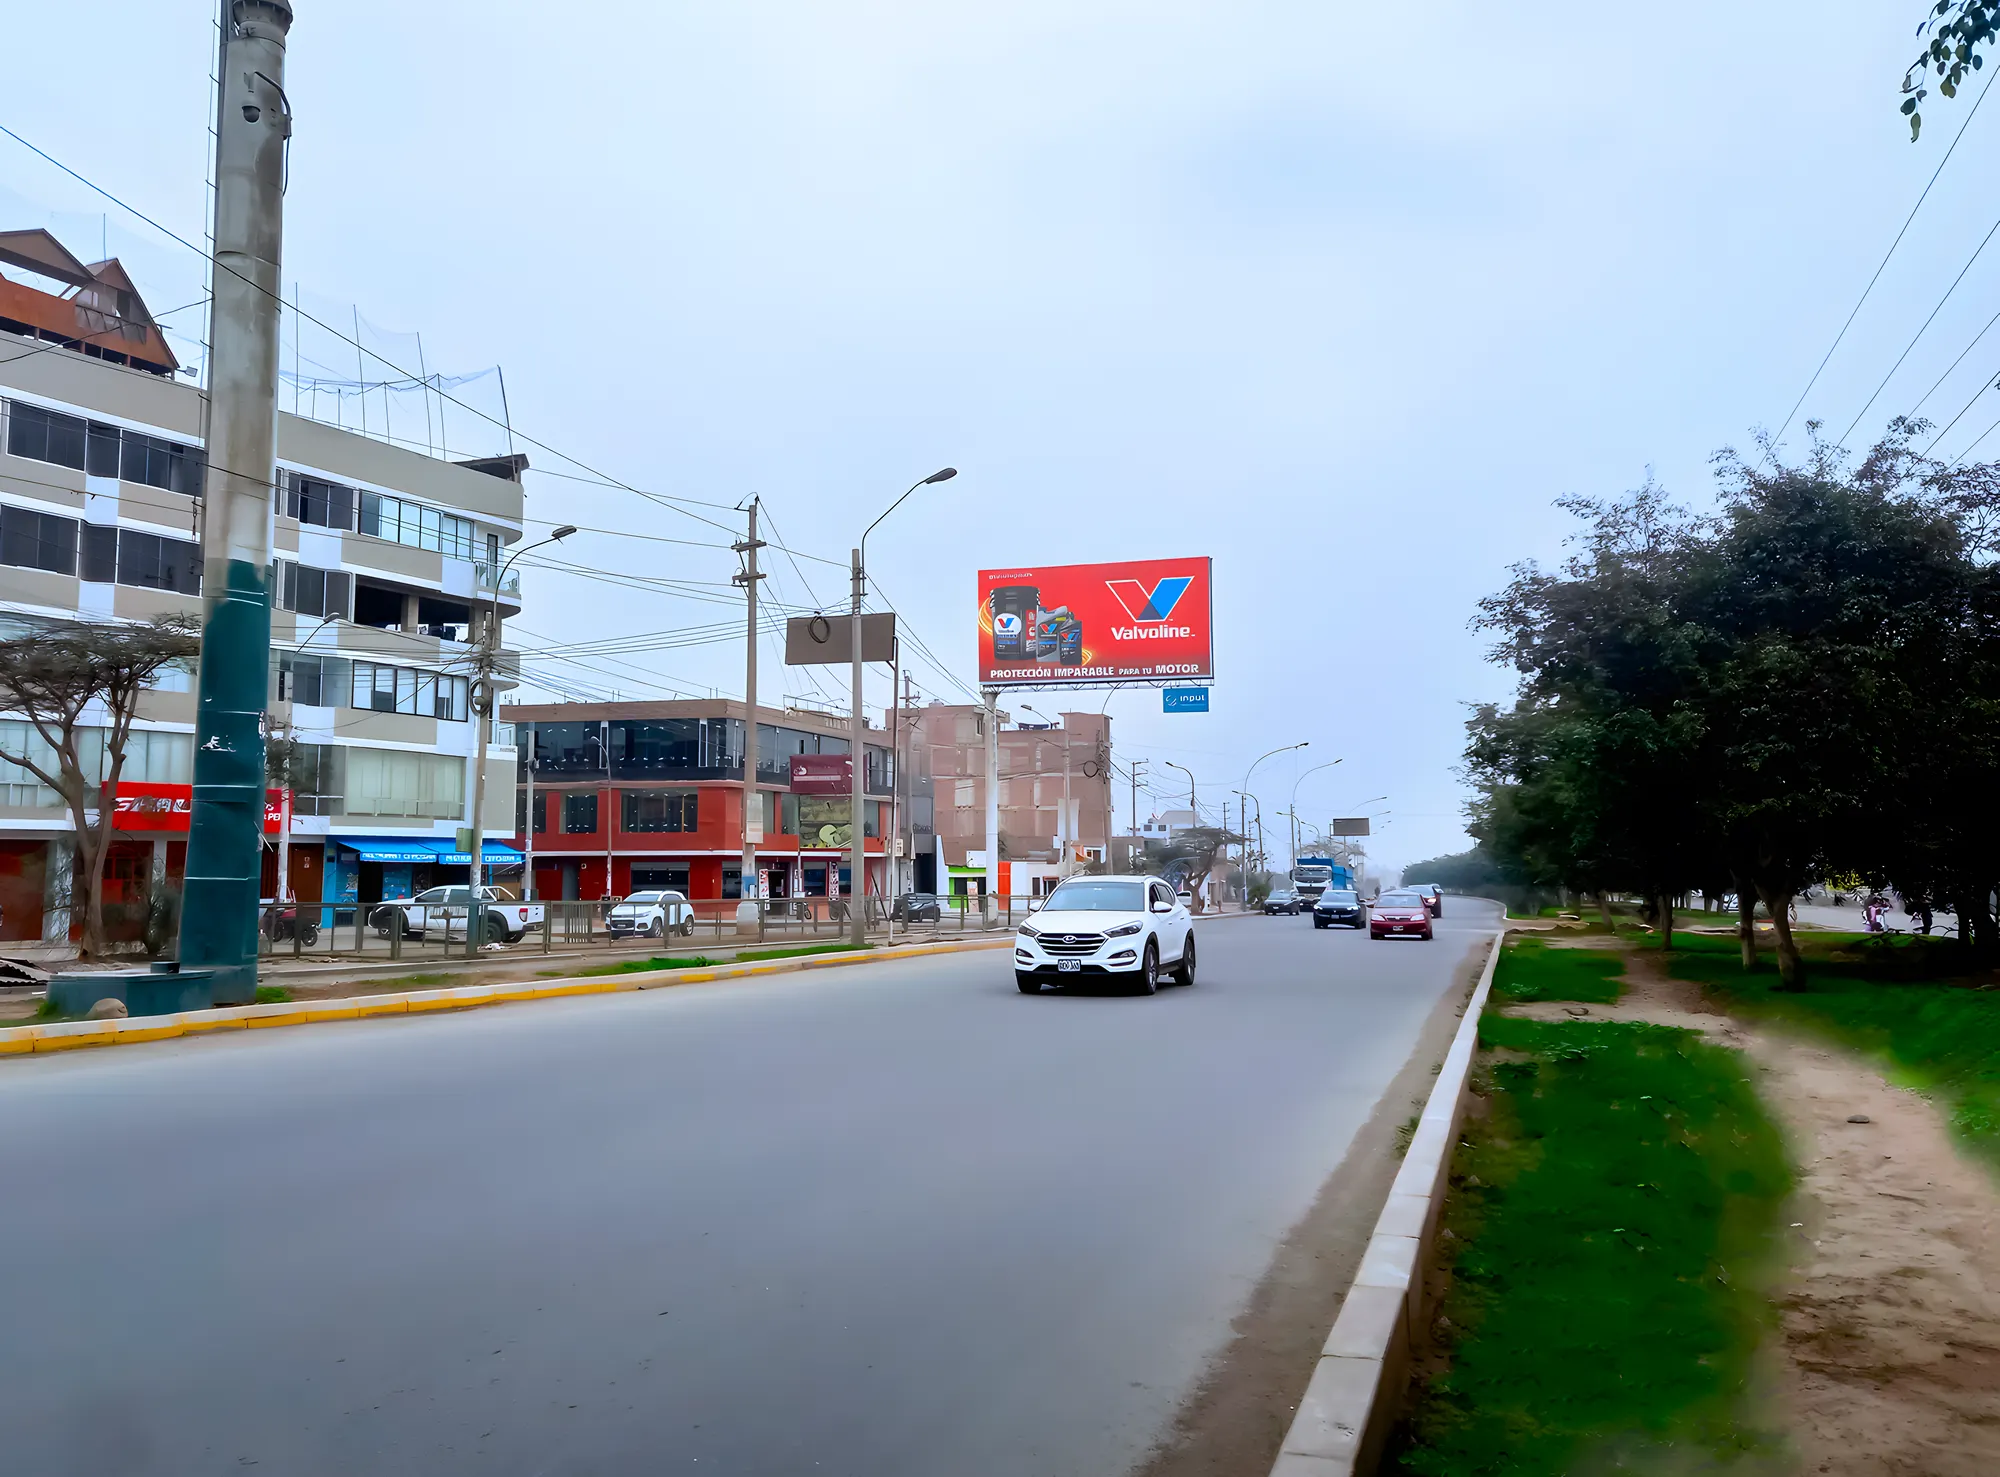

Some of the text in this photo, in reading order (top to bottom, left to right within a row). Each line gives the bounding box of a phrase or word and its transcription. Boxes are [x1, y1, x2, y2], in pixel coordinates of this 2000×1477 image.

[1111, 625, 1191, 640] Valvoline
[990, 667, 1051, 679] PROTECCIÓN
[1054, 666, 1114, 677] IMPARABLE
[1155, 664, 1199, 674] MOTOR
